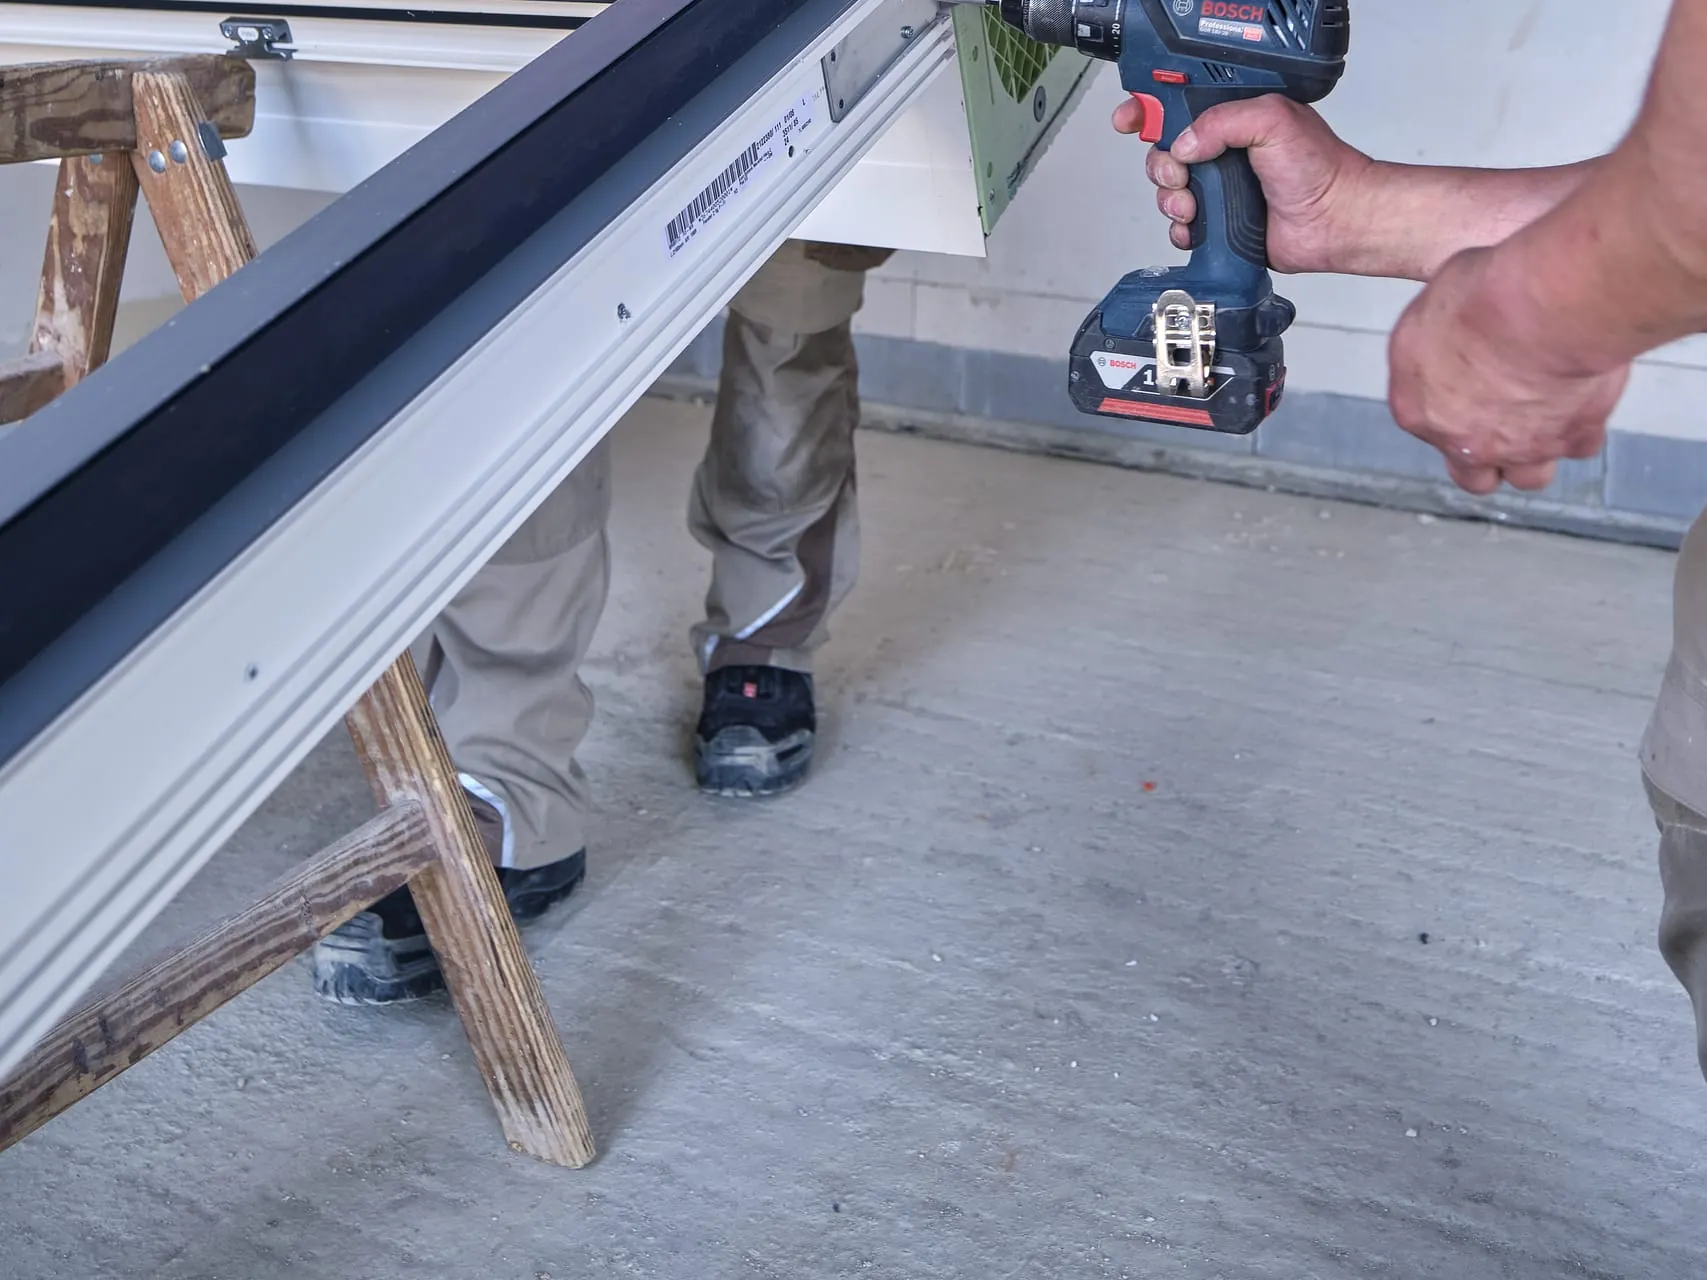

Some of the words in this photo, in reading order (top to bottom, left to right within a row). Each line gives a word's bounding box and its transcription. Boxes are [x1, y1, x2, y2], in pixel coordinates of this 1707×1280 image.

[1201, 0, 1264, 22] BOSCH
[1111, 23, 1120, 35] 20
[1109, 359, 1136, 369] BOSCH
